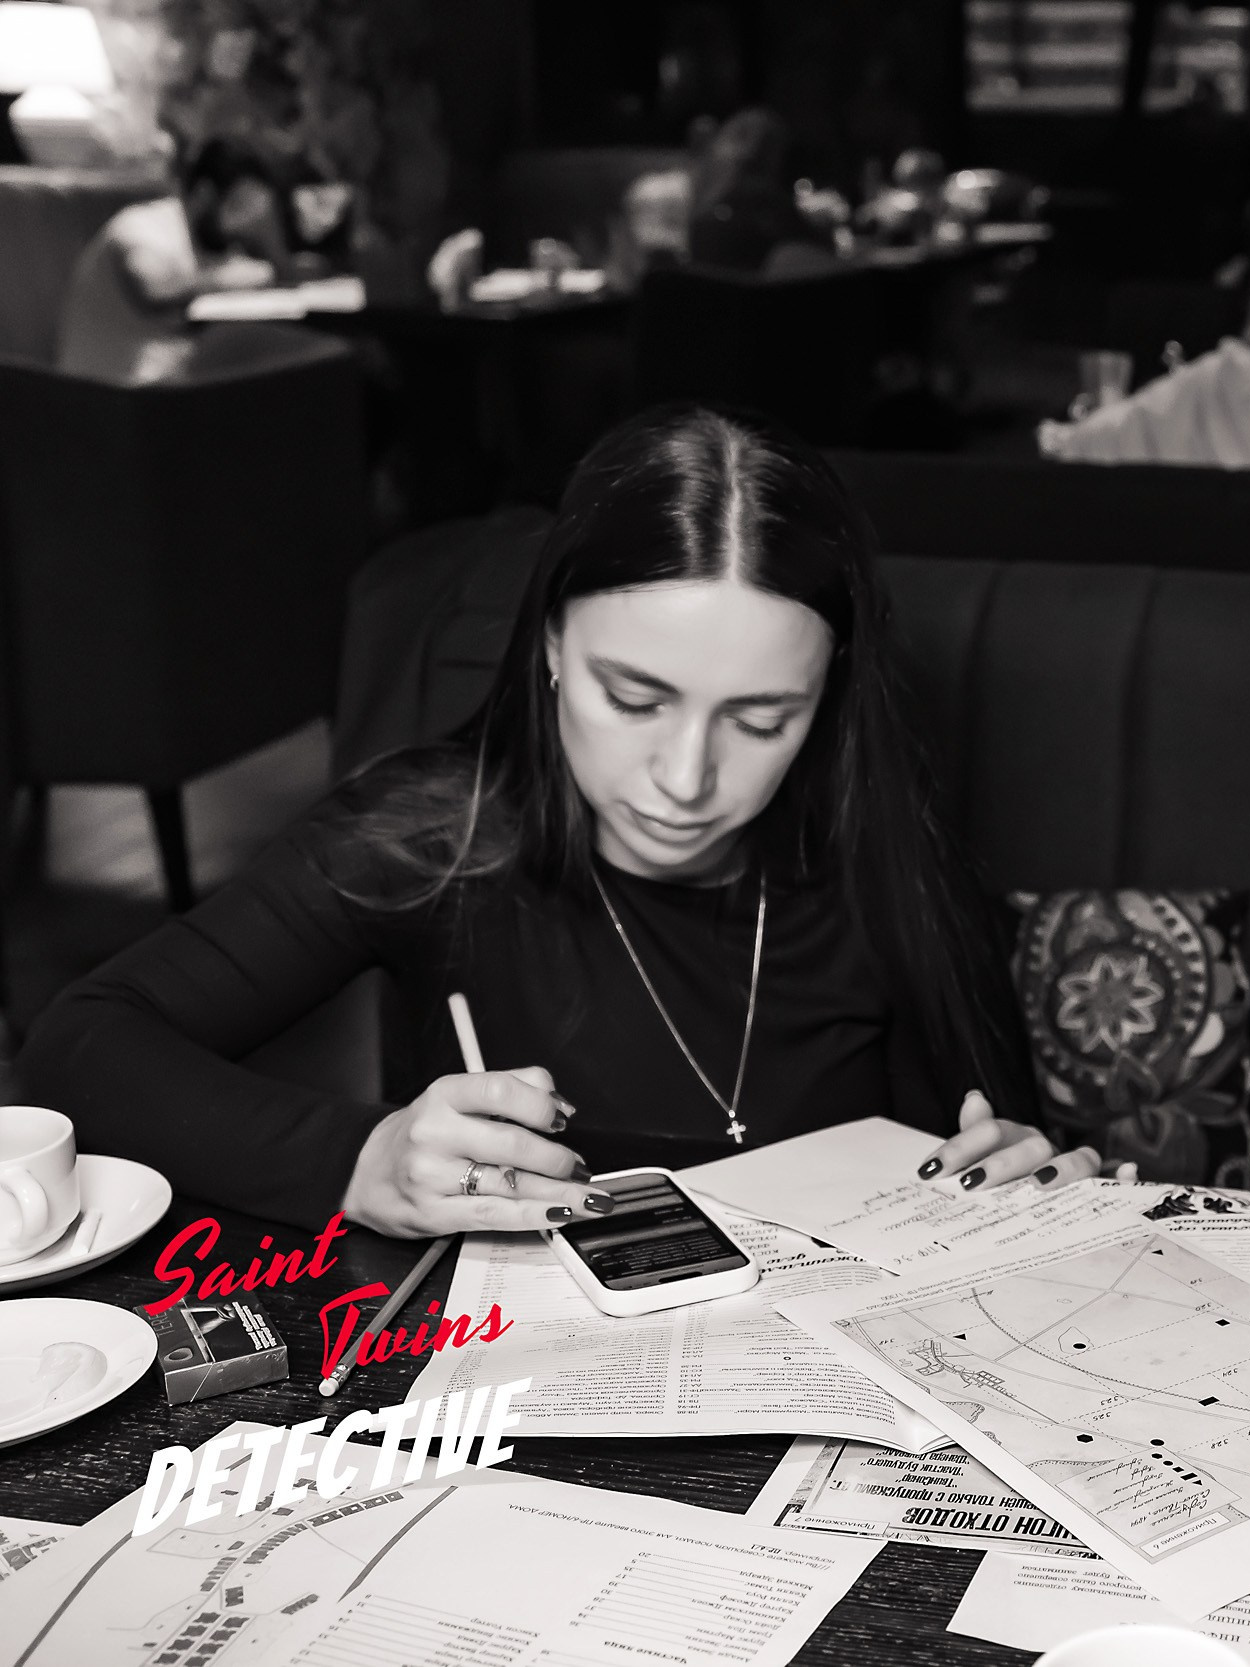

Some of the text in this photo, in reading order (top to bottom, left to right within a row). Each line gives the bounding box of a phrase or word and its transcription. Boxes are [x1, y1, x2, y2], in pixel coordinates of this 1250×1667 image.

[1210, 1438, 1229, 1449] 328
[860, 1458, 918, 1472] Будущего"
[853, 1481, 934, 1502] пропусками
[935, 1492, 945, 1501] с
[949, 1490, 995, 1506] только
[804, 1517, 875, 1530] Приложение
[901, 1506, 1010, 1531] ОТХОДОВ
[594, 1520, 629, 1531] введите
[1160, 1518, 1217, 1546] Приложение
[714, 1543, 765, 1558] совершать
[767, 1554, 803, 1566] можете
[739, 1571, 773, 1583] Эдвард
[1021, 1565, 1111, 1580] будет заниматься
[743, 1581, 773, 1592] Томас
[776, 1578, 814, 1591] Маккей
[1017, 1572, 1142, 1591] которого было совершено
[745, 1591, 767, 1600] Роуз
[776, 1587, 807, 1598] Келли
[1012, 1580, 1147, 1601] региональному отделению
[719, 1594, 757, 1608] Джозеф
[770, 1595, 801, 1607] Келли
[759, 1602, 794, 1615] Картер
[1199, 1631, 1241, 1642] ИНФ
[603, 1640, 688, 1665] Частные лица
